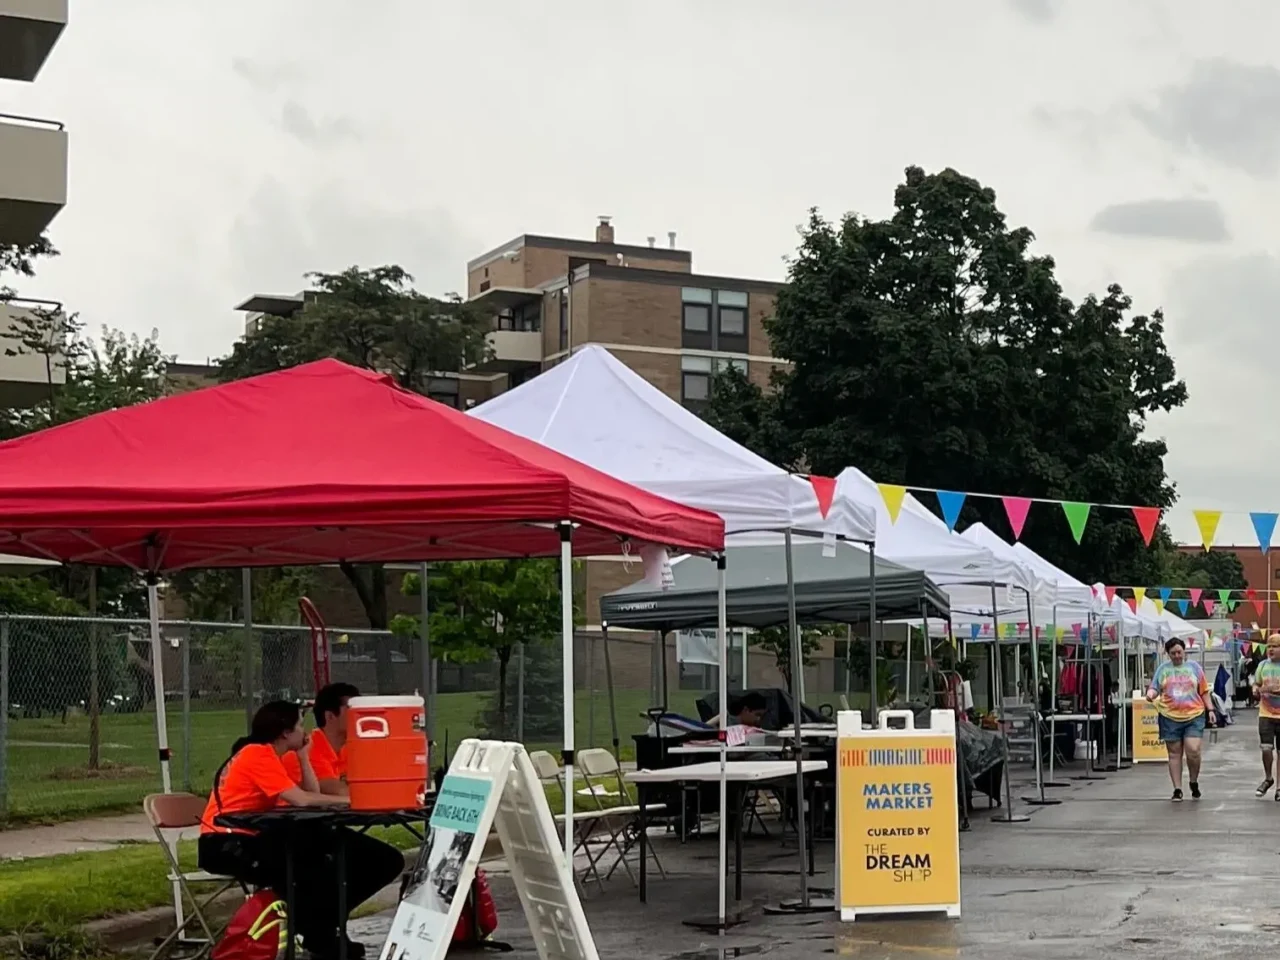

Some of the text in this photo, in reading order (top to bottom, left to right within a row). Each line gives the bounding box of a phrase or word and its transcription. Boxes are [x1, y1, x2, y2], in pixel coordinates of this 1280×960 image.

[863, 782, 932, 795] MAKERS
[866, 796, 934, 809] MARKET
[867, 827, 930, 837] CURATED BY
[864, 843, 888, 855] THE
[866, 854, 931, 870] DREAM
